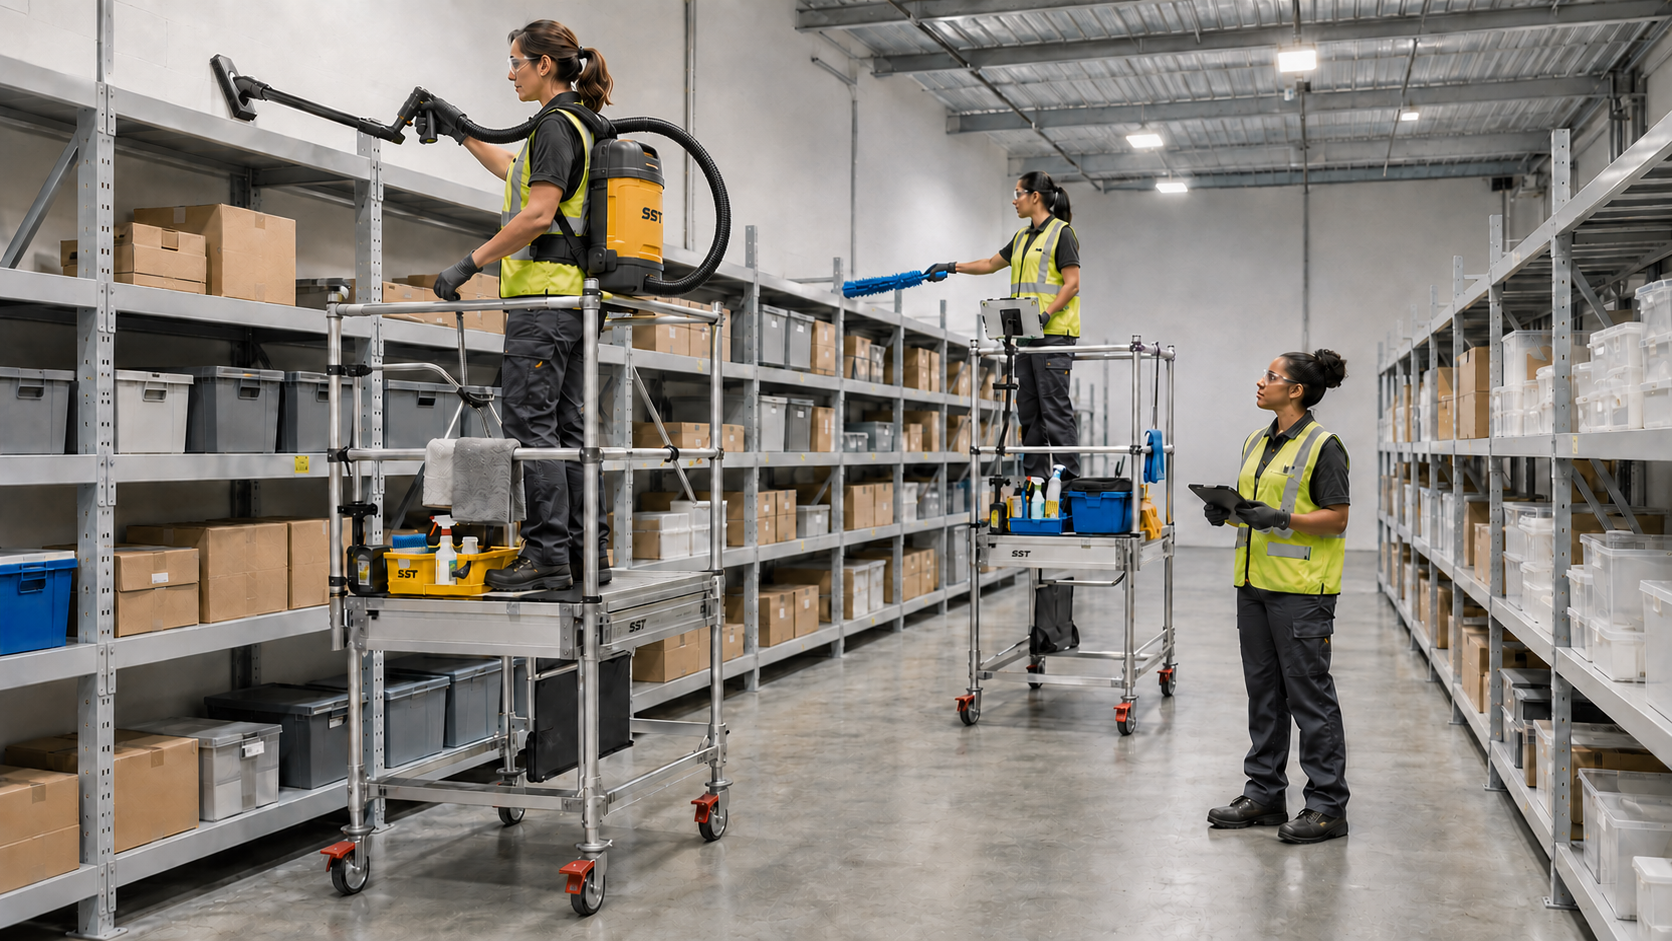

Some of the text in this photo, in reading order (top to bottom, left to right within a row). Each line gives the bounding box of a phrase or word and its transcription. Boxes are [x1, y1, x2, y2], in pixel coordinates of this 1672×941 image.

[641, 206, 663, 224] SST
[1011, 549, 1031, 558] SST
[397, 569, 418, 579] SST
[629, 619, 647, 633] SST
